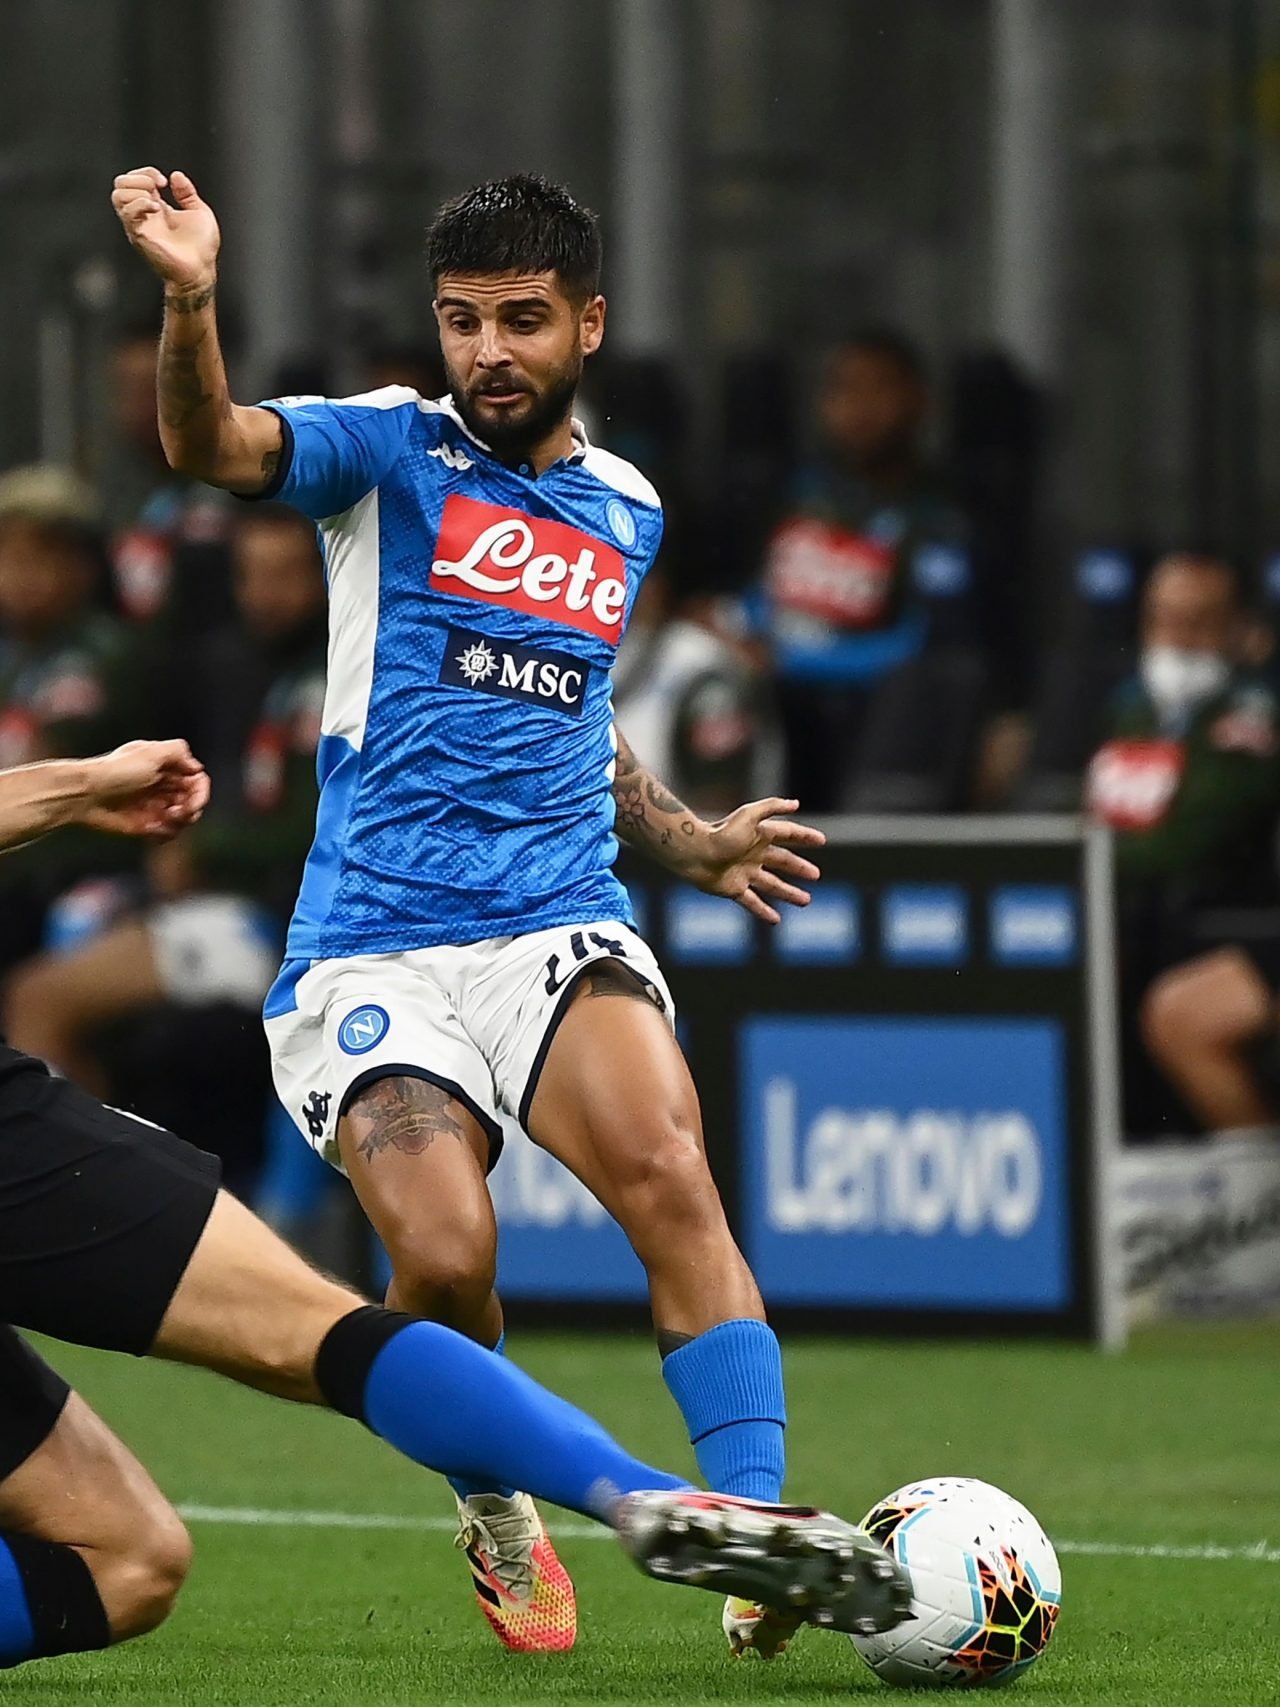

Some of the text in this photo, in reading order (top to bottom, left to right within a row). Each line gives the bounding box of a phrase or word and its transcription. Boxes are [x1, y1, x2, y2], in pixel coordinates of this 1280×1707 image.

[431, 519, 626, 626] Lete
[497, 653, 582, 704] MSC
[348, 1015, 376, 1044] N
[764, 1076, 1044, 1238] Lenovo
